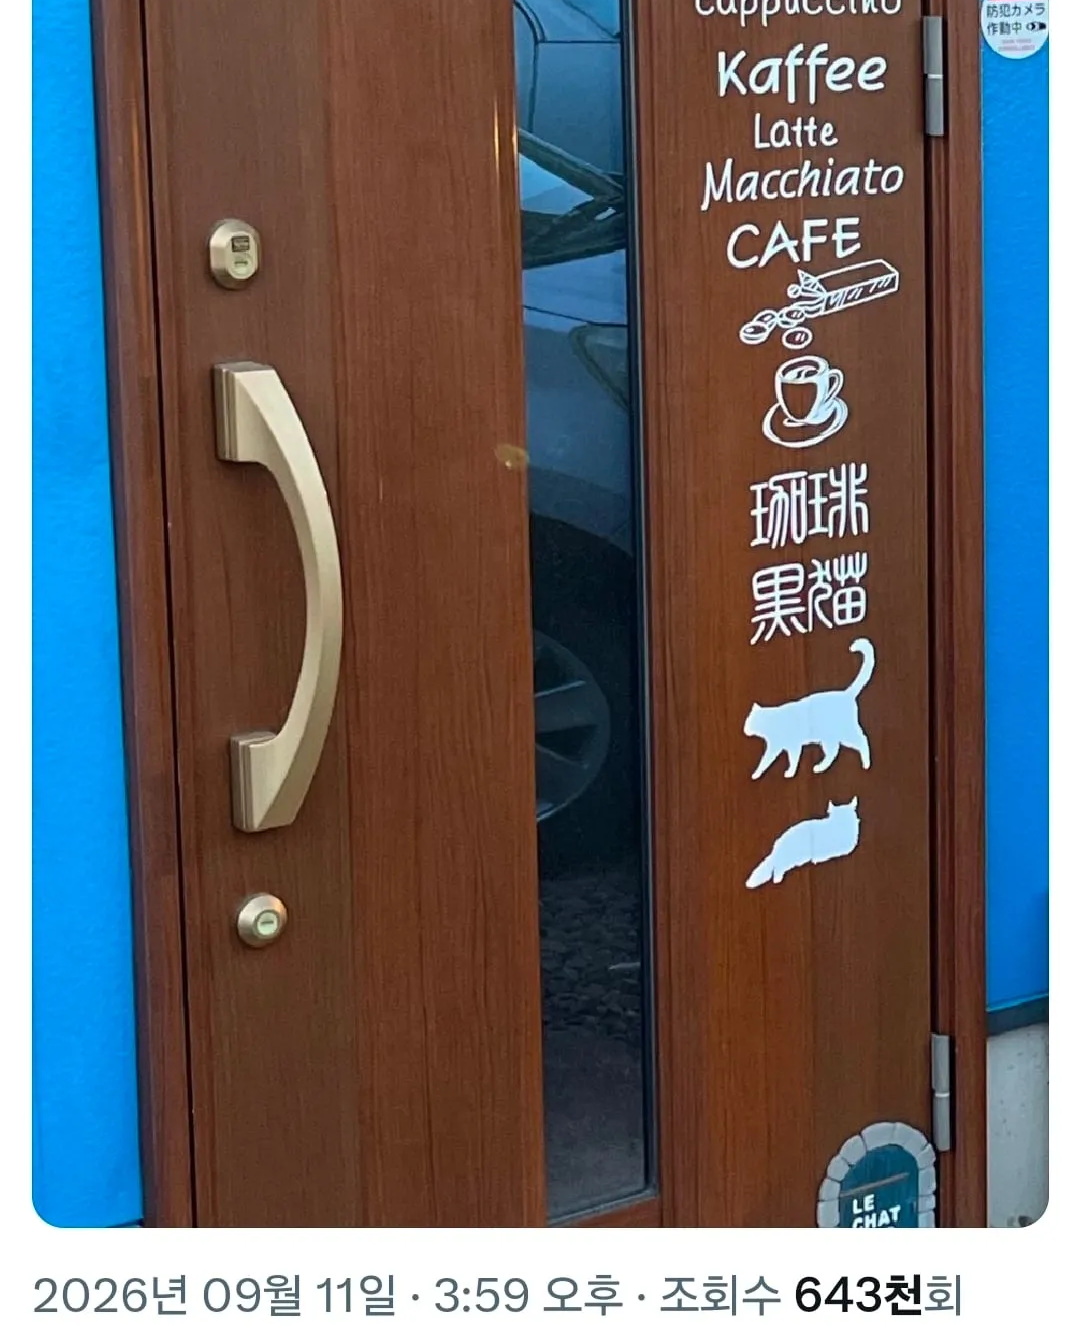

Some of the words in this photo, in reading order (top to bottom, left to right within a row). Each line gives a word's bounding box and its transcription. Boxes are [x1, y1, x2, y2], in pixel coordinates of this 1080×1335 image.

[986, 3, 1046, 19] 防犯カメラ
[987, 22, 1022, 36] 作動中
[718, 43, 887, 105] Kaffee
[754, 112, 839, 149] Latte
[700, 157, 904, 211] Macchiato
[726, 216, 862, 269] CAFE
[750, 462, 869, 549] 珈琲
[750, 551, 868, 645] 黒猫
[852, 1193, 876, 1215] LE
[852, 1204, 902, 1228] CHAT
